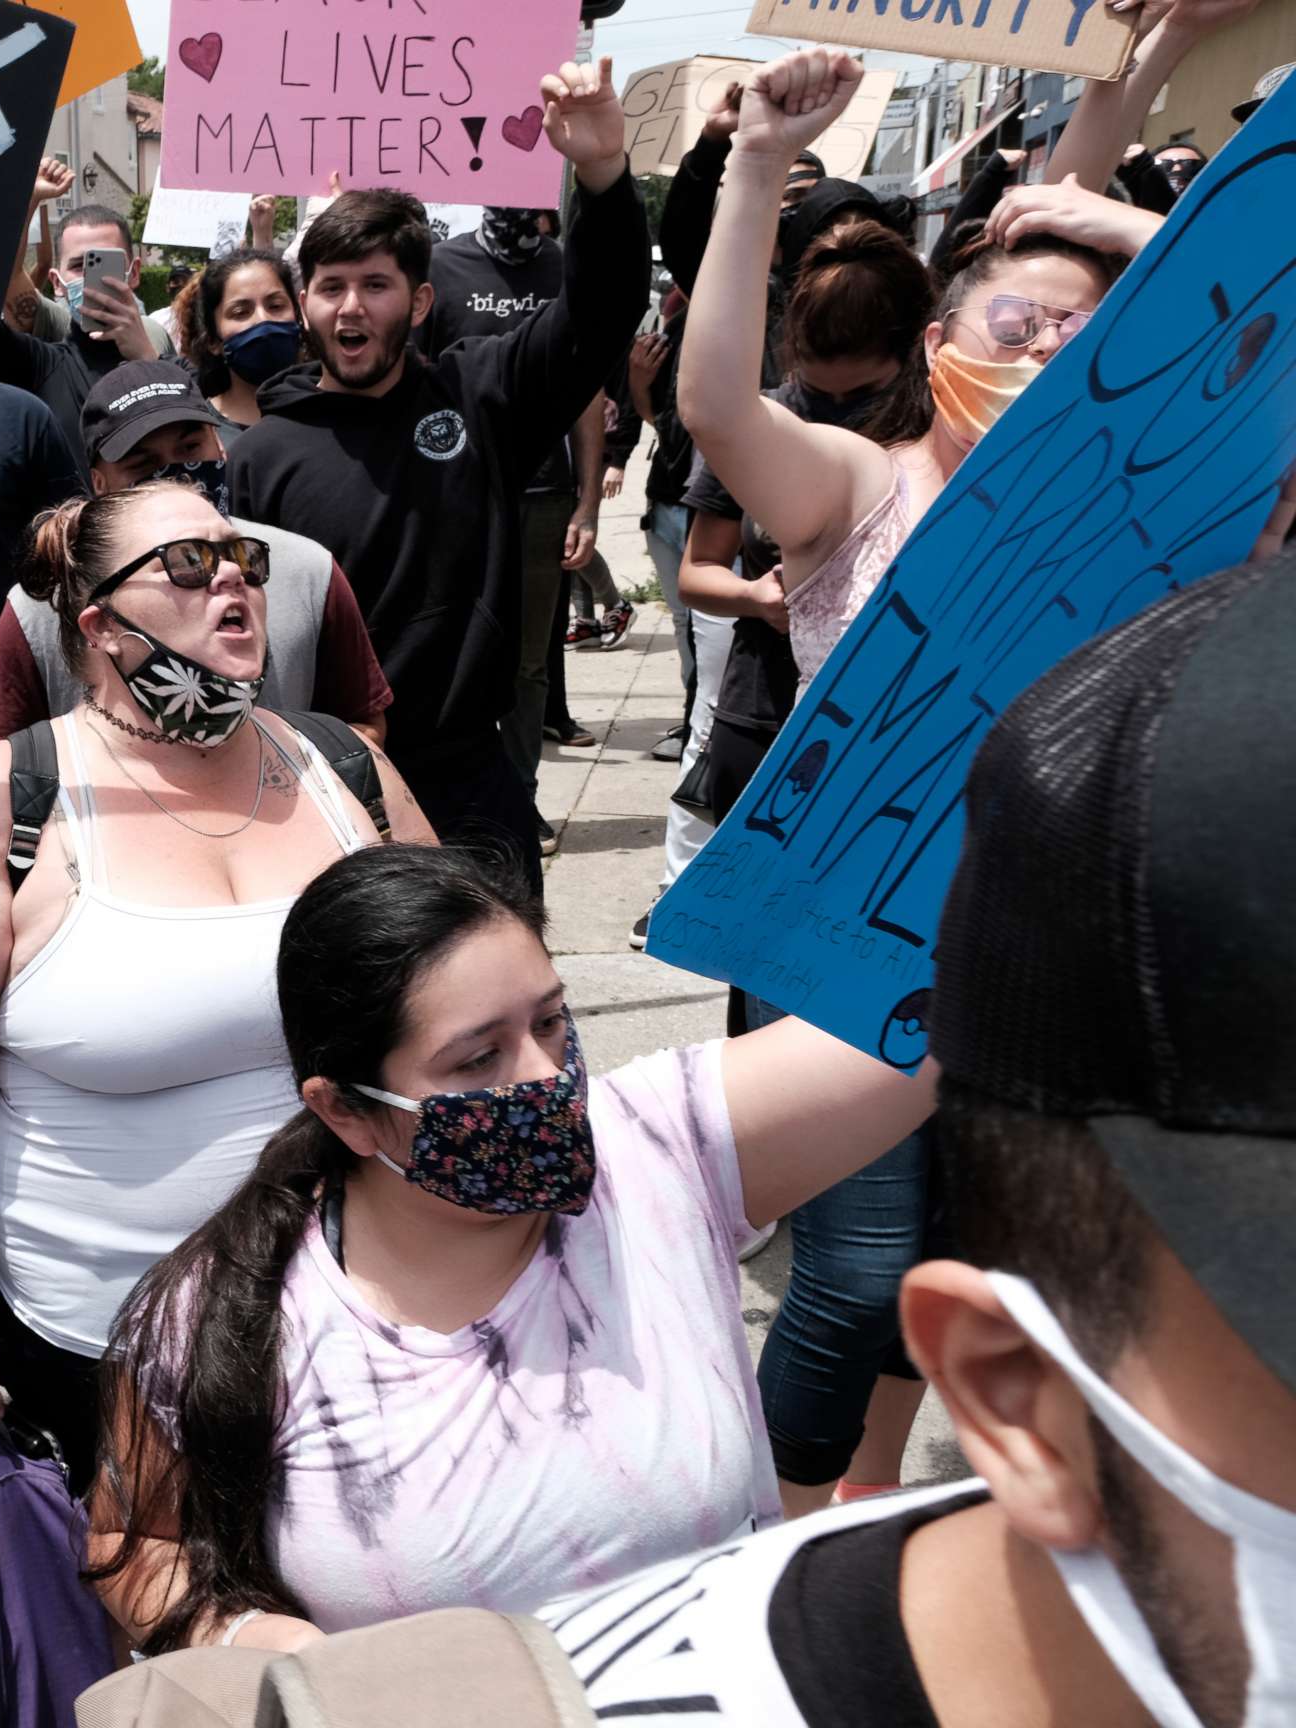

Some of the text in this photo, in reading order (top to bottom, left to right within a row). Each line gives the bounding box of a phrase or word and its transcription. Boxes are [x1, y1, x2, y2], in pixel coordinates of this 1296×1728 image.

[281, 30, 475, 106] LIVES
[195, 112, 487, 177] MATTER!
[814, 712, 984, 960] AL
